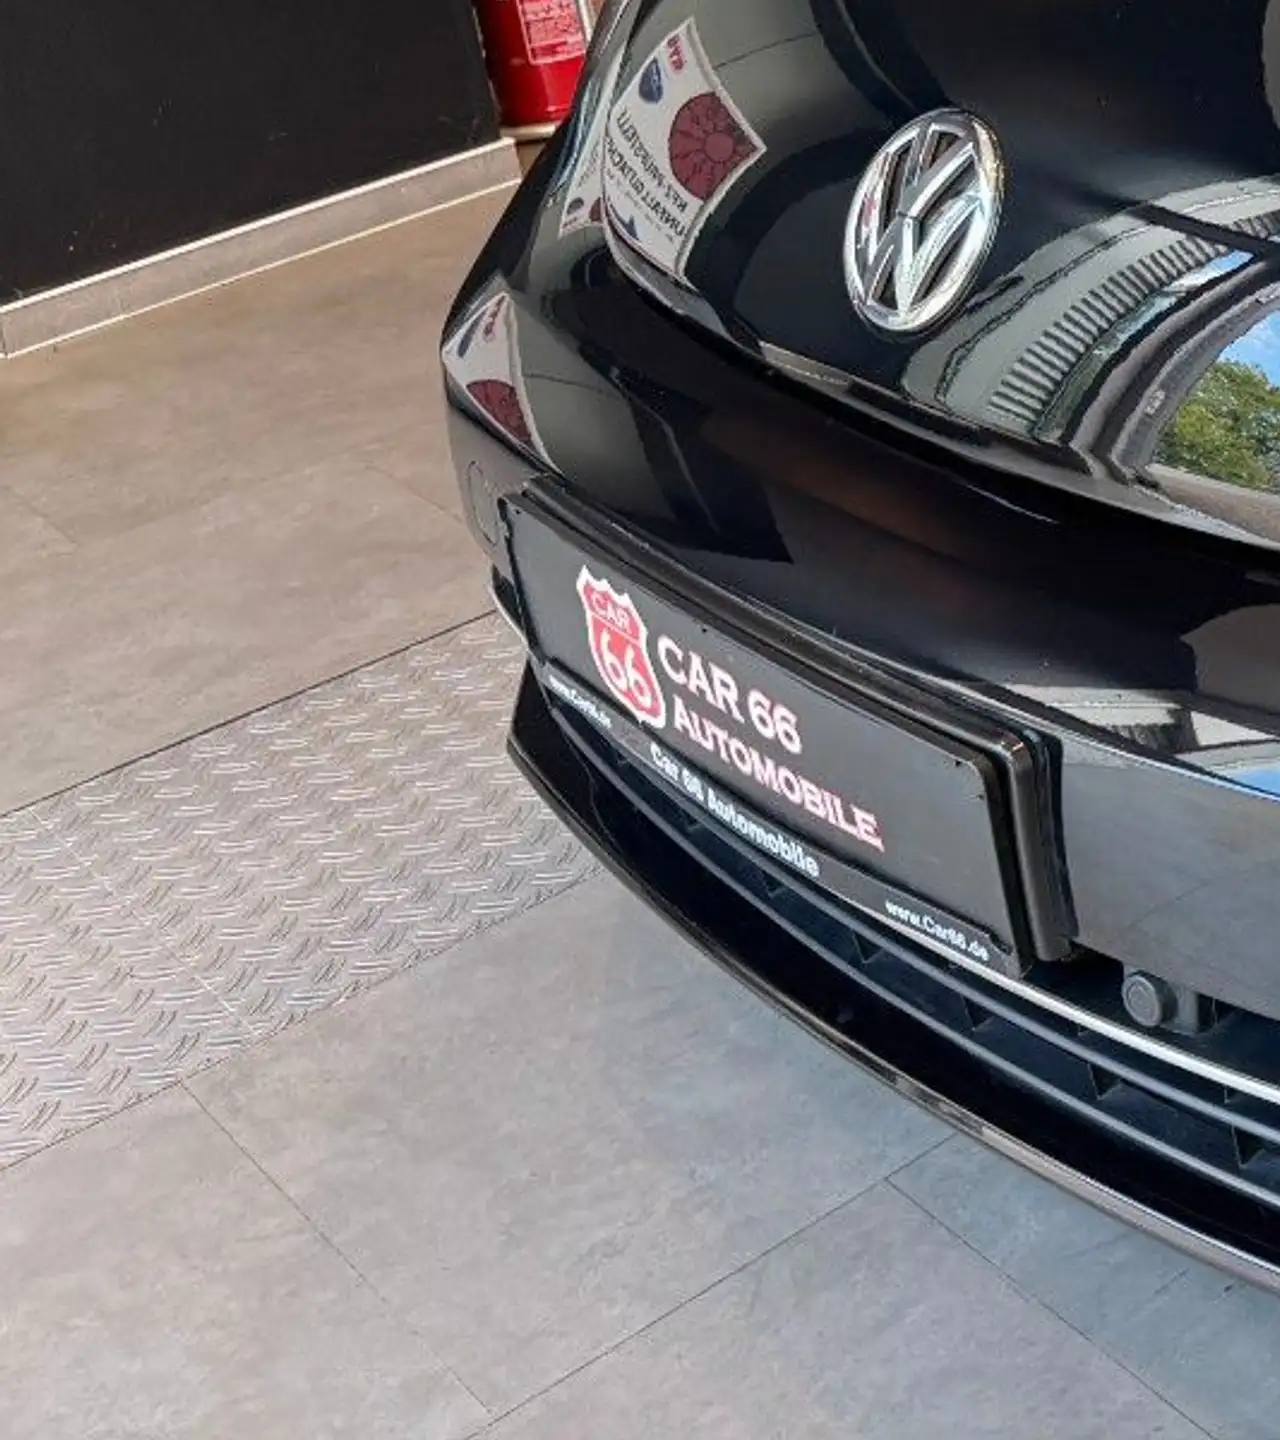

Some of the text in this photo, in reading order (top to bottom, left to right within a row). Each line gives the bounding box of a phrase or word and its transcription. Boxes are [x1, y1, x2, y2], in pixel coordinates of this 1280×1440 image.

[591, 594, 633, 635] CAR
[600, 627, 653, 709] 66
[656, 633, 803, 755] CAR 66
[649, 741, 679, 782] Car
[705, 786, 821, 879] Automobile
[672, 693, 886, 854] AUTOMOBILE
